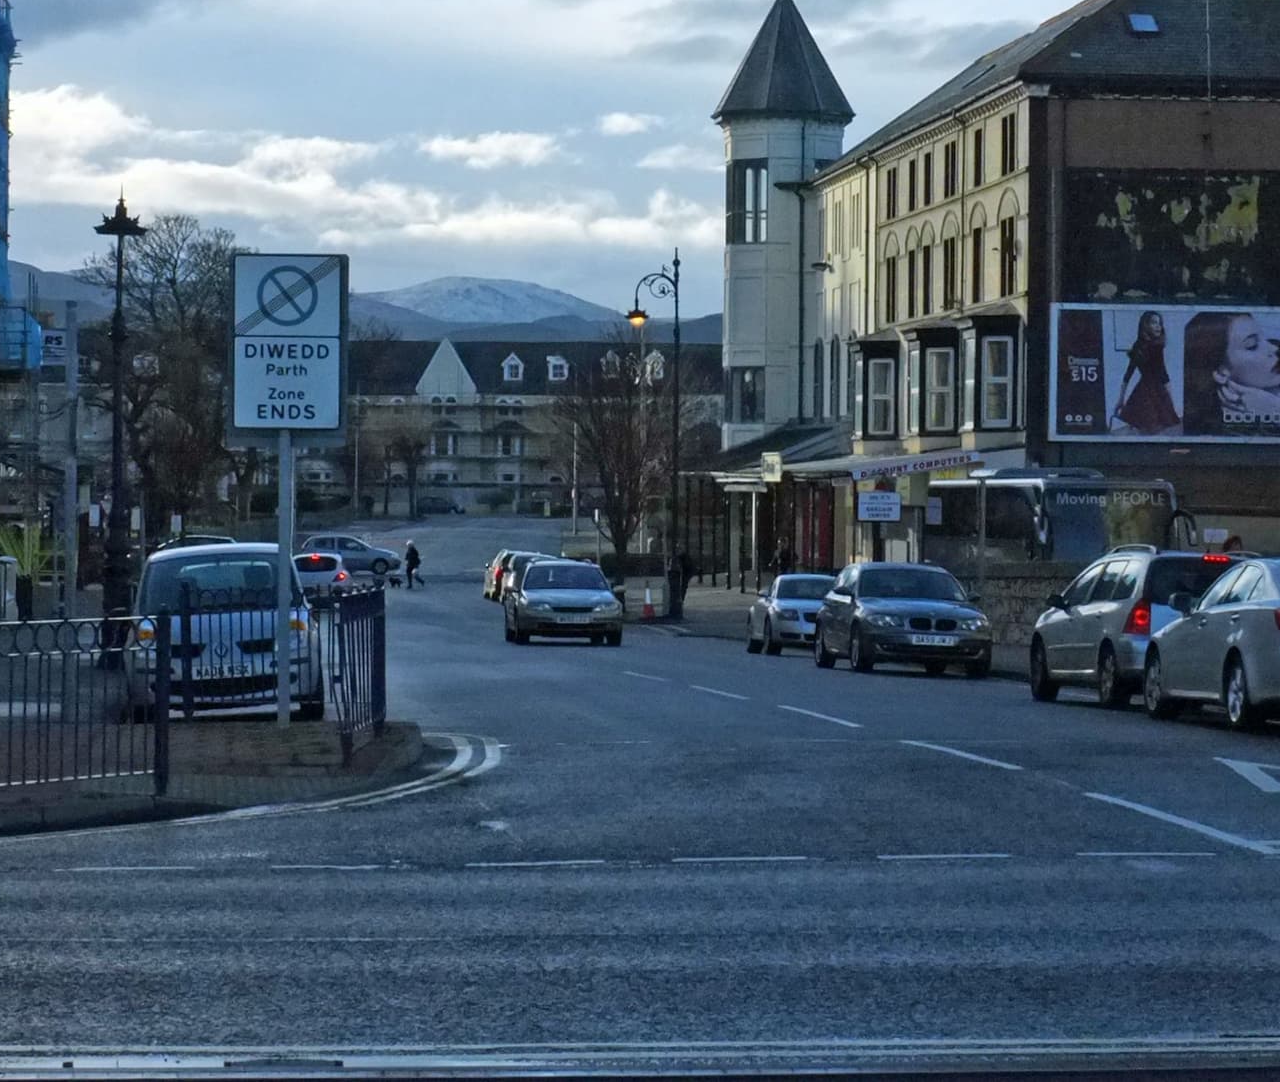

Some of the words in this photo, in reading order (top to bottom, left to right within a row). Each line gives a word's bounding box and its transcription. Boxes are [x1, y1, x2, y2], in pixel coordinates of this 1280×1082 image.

[244, 343, 330, 359] DIWEDD
[265, 364, 308, 376] Parth
[1071, 366, 1099, 382] £15
[267, 387, 306, 400] Zone
[256, 404, 316, 420] ENDS
[912, 455, 972, 470] COMPUTERS
[1056, 492, 1107, 507] Moving
[1112, 492, 1165, 506] PEOPLE
